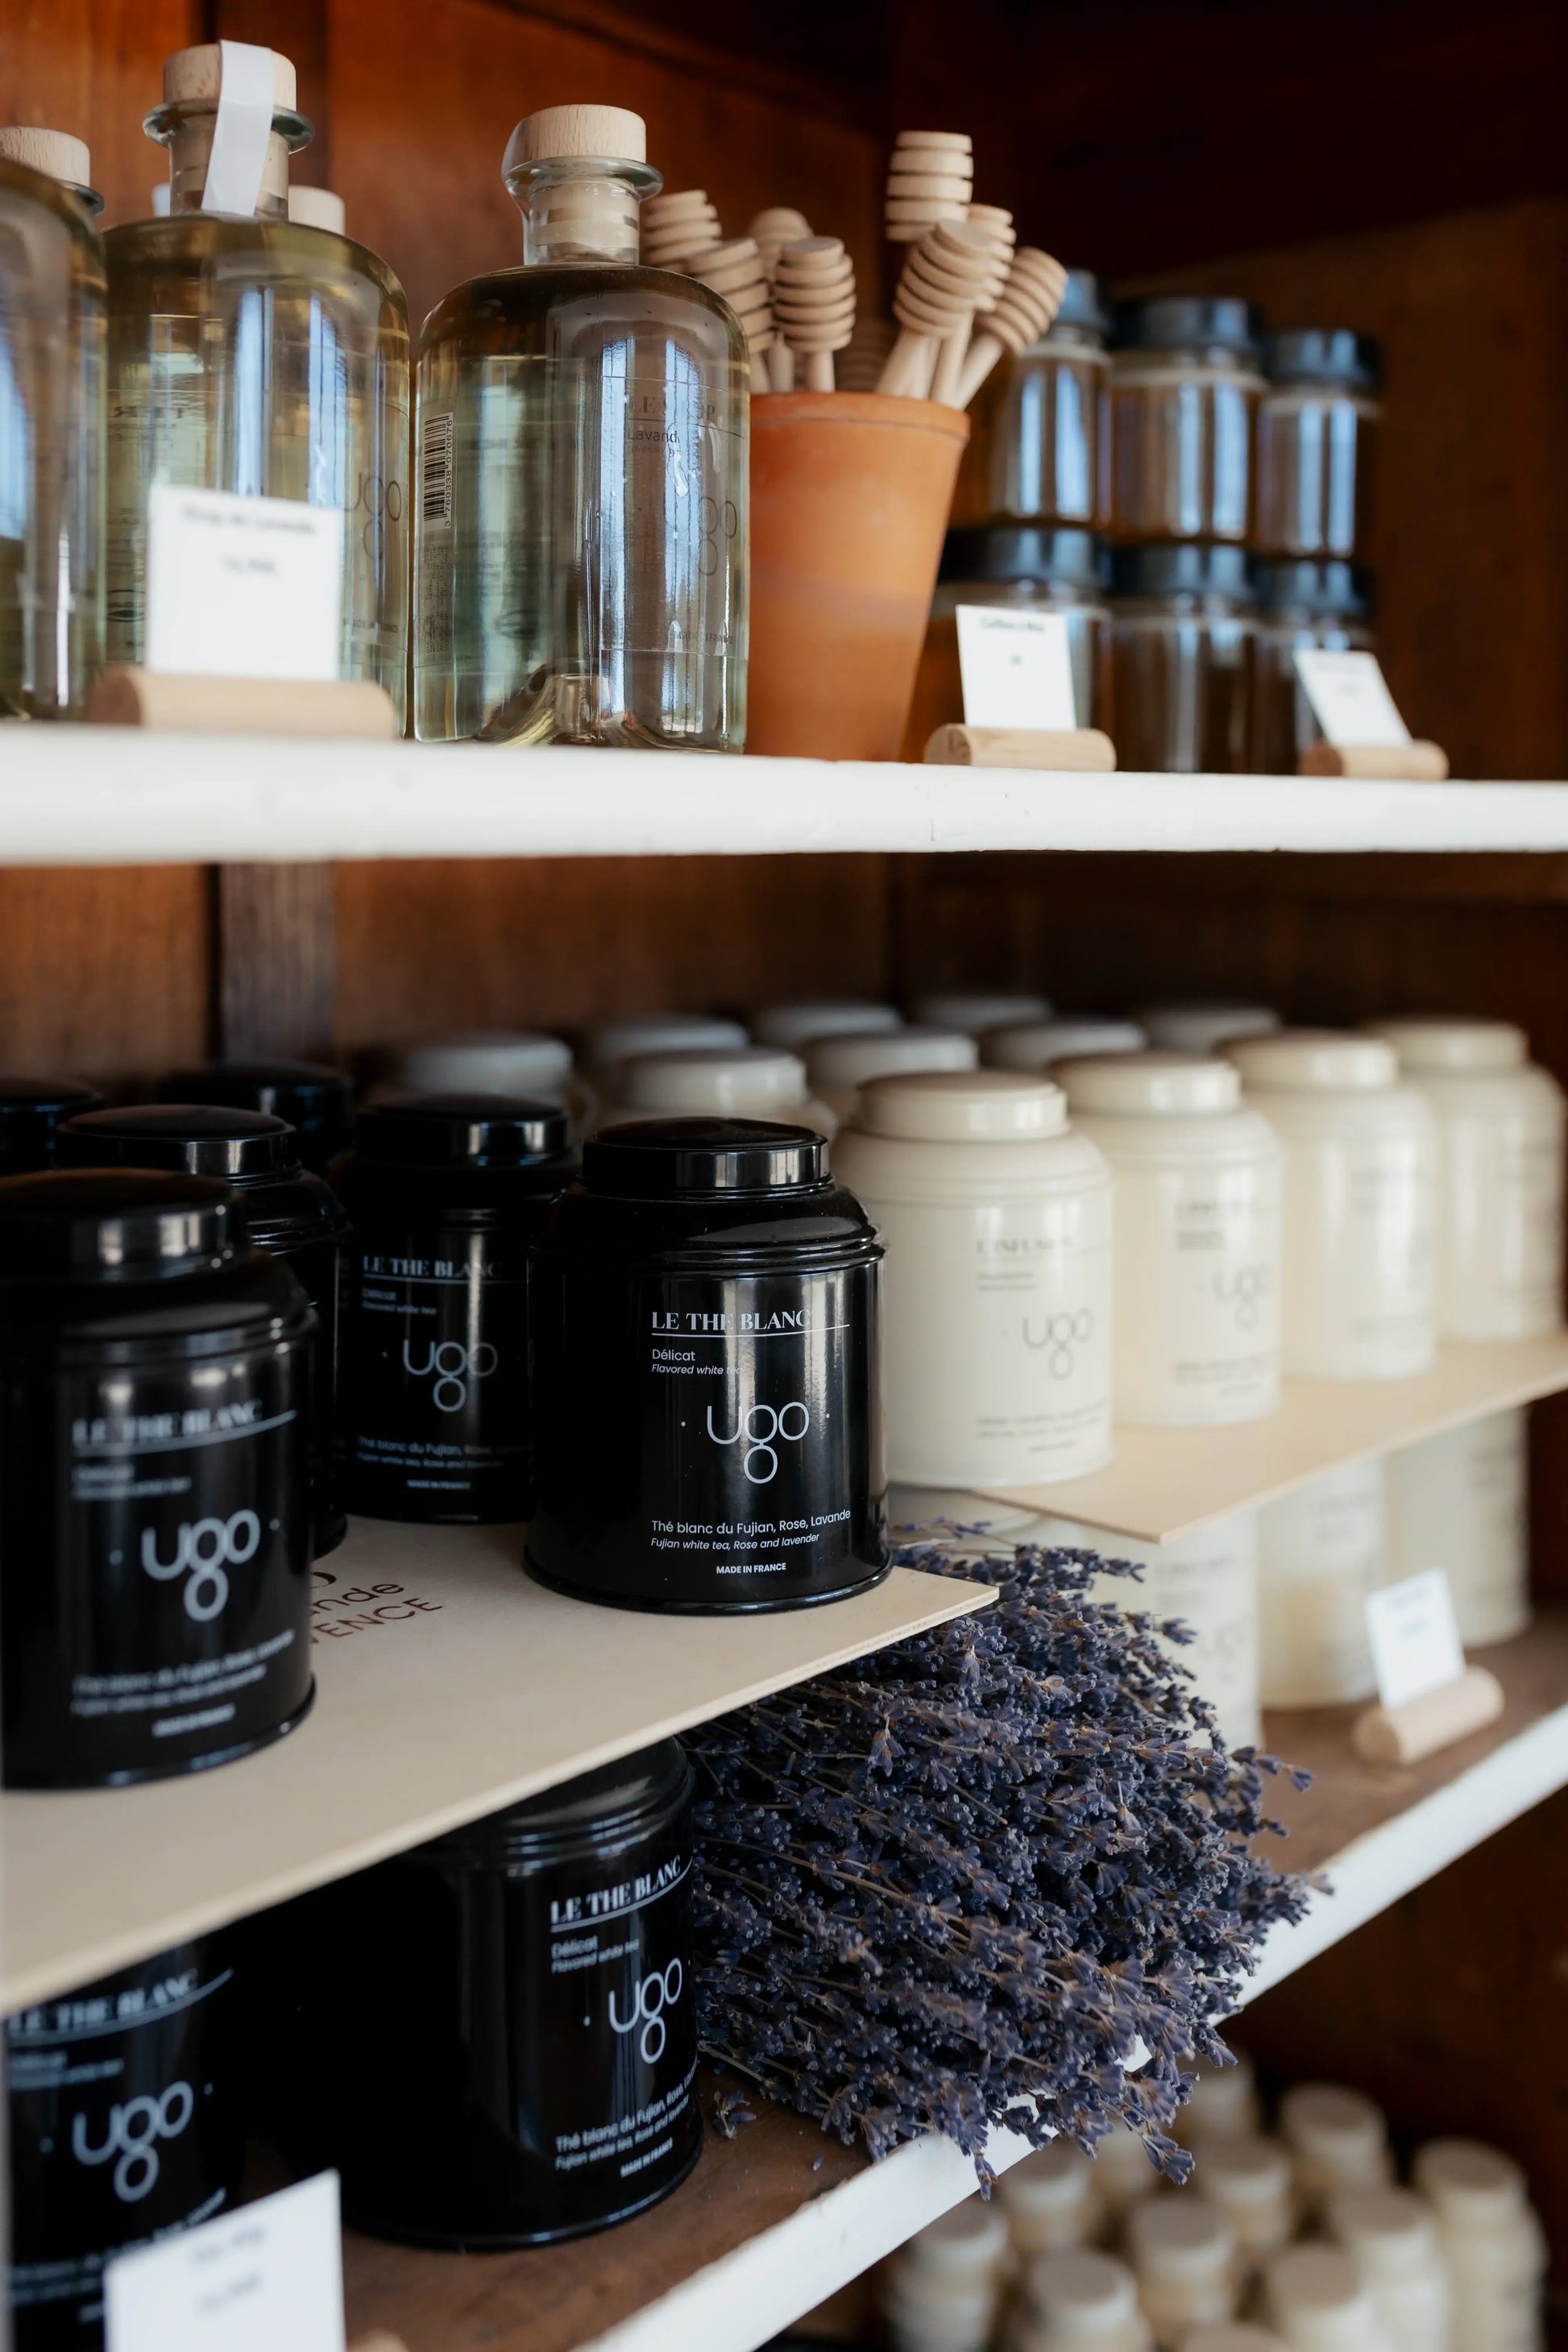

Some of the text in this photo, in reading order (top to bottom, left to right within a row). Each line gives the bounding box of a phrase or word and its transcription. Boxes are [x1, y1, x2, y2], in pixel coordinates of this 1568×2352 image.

[363, 1255, 385, 1273] LE
[389, 1258, 429, 1276] THE
[652, 1309, 810, 1331] LE THE BLANC
[651, 1363, 695, 1375] Flavored
[698, 1365, 724, 1375] white
[652, 1348, 696, 1362] Délicat
[403, 1338, 499, 1412] ugo
[707, 1401, 810, 1484] ugo
[652, 1508, 852, 1537] Thé blanc du Fujian, Rose, Lavande
[650, 1533, 821, 1551] Fujian white tea, Rose and lavender
[140, 1509, 260, 1622] ugo
[716, 1562, 787, 1574] MADE IN FRANCE
[311, 1583, 404, 1616] nde
[311, 1597, 443, 1645] ENCE
[550, 1854, 681, 1925] LE THE BLANC
[608, 1956, 683, 2064] ugo
[72, 2080, 194, 2203] ugo
